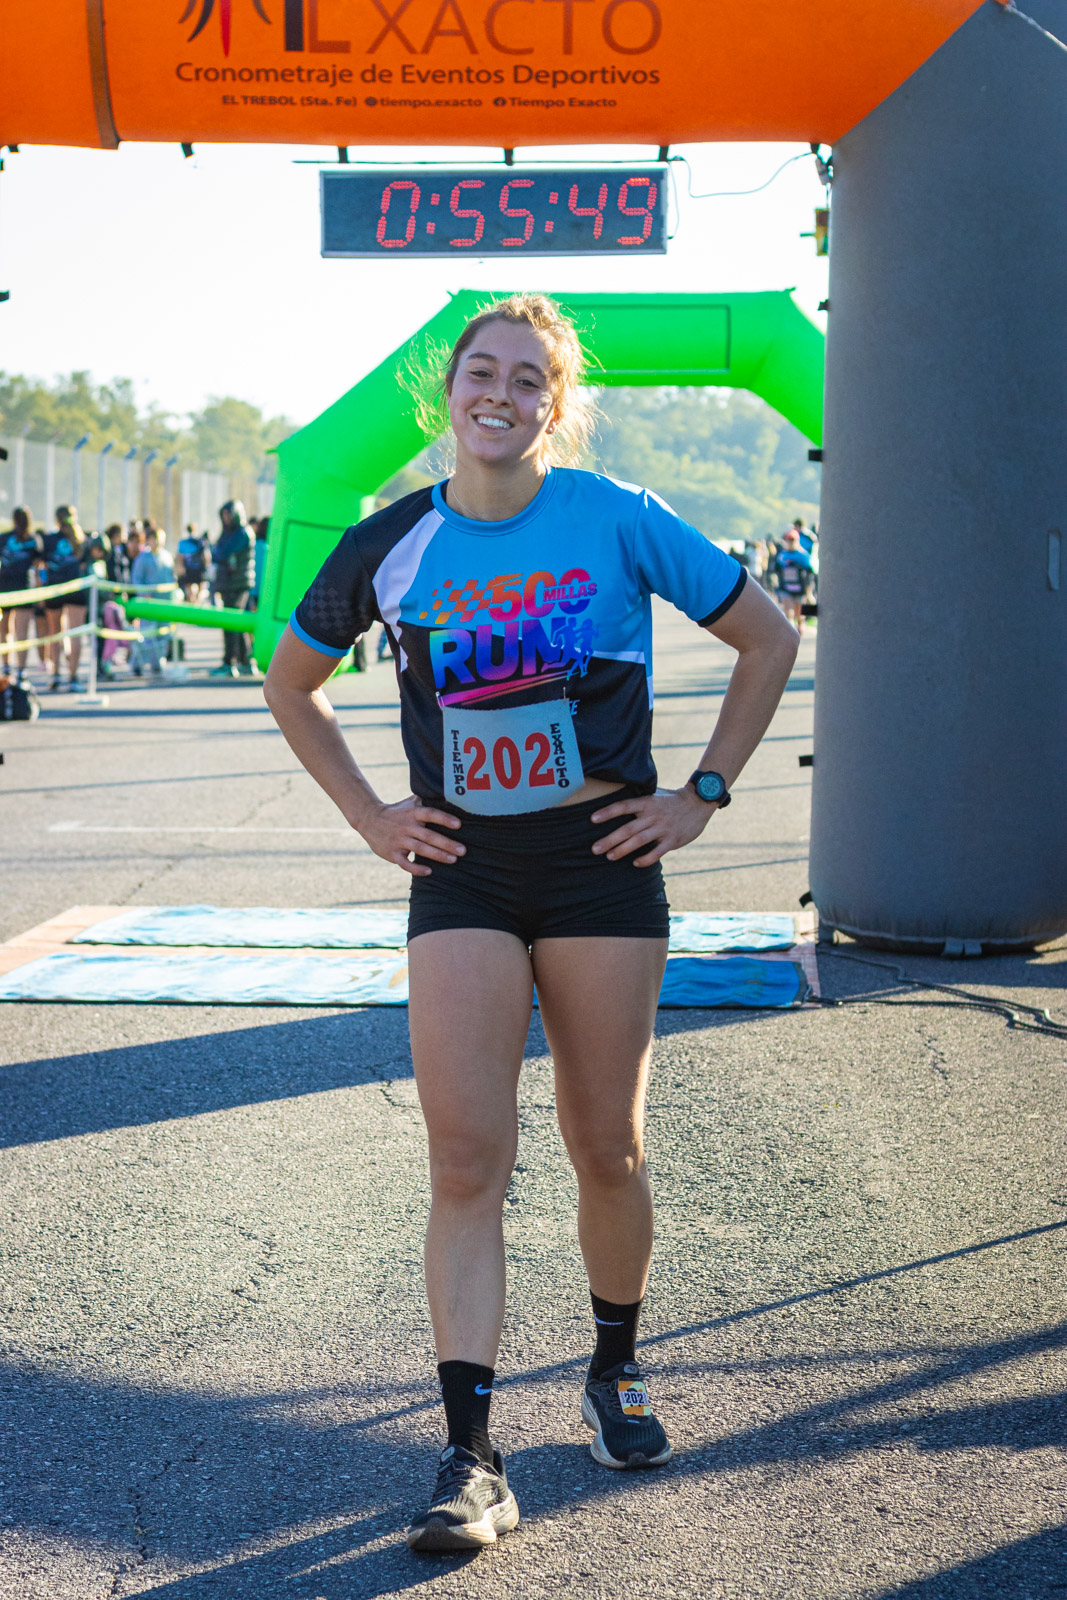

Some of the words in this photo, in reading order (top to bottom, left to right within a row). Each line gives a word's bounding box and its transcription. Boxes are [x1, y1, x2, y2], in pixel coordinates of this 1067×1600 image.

[175, 62, 353, 87] Cronometraje
[360, 63, 393, 84] de
[401, 64, 505, 84] Eventos
[513, 65, 661, 88] Deportivos
[222, 94, 239, 105] EL
[242, 94, 297, 106] TREBOL
[336, 96, 357, 107] Fe)
[509, 97, 565, 109] Tiempo
[568, 97, 618, 107] Exacto
[376, 177, 657, 248] 0:55:49
[543, 582, 598, 602] MILLAS
[429, 617, 571, 689] RUN
[451, 729, 466, 796] TIEMPO
[463, 732, 555, 790] 202
[550, 723, 569, 788] EXACTO
[624, 1392, 645, 1404] 202
